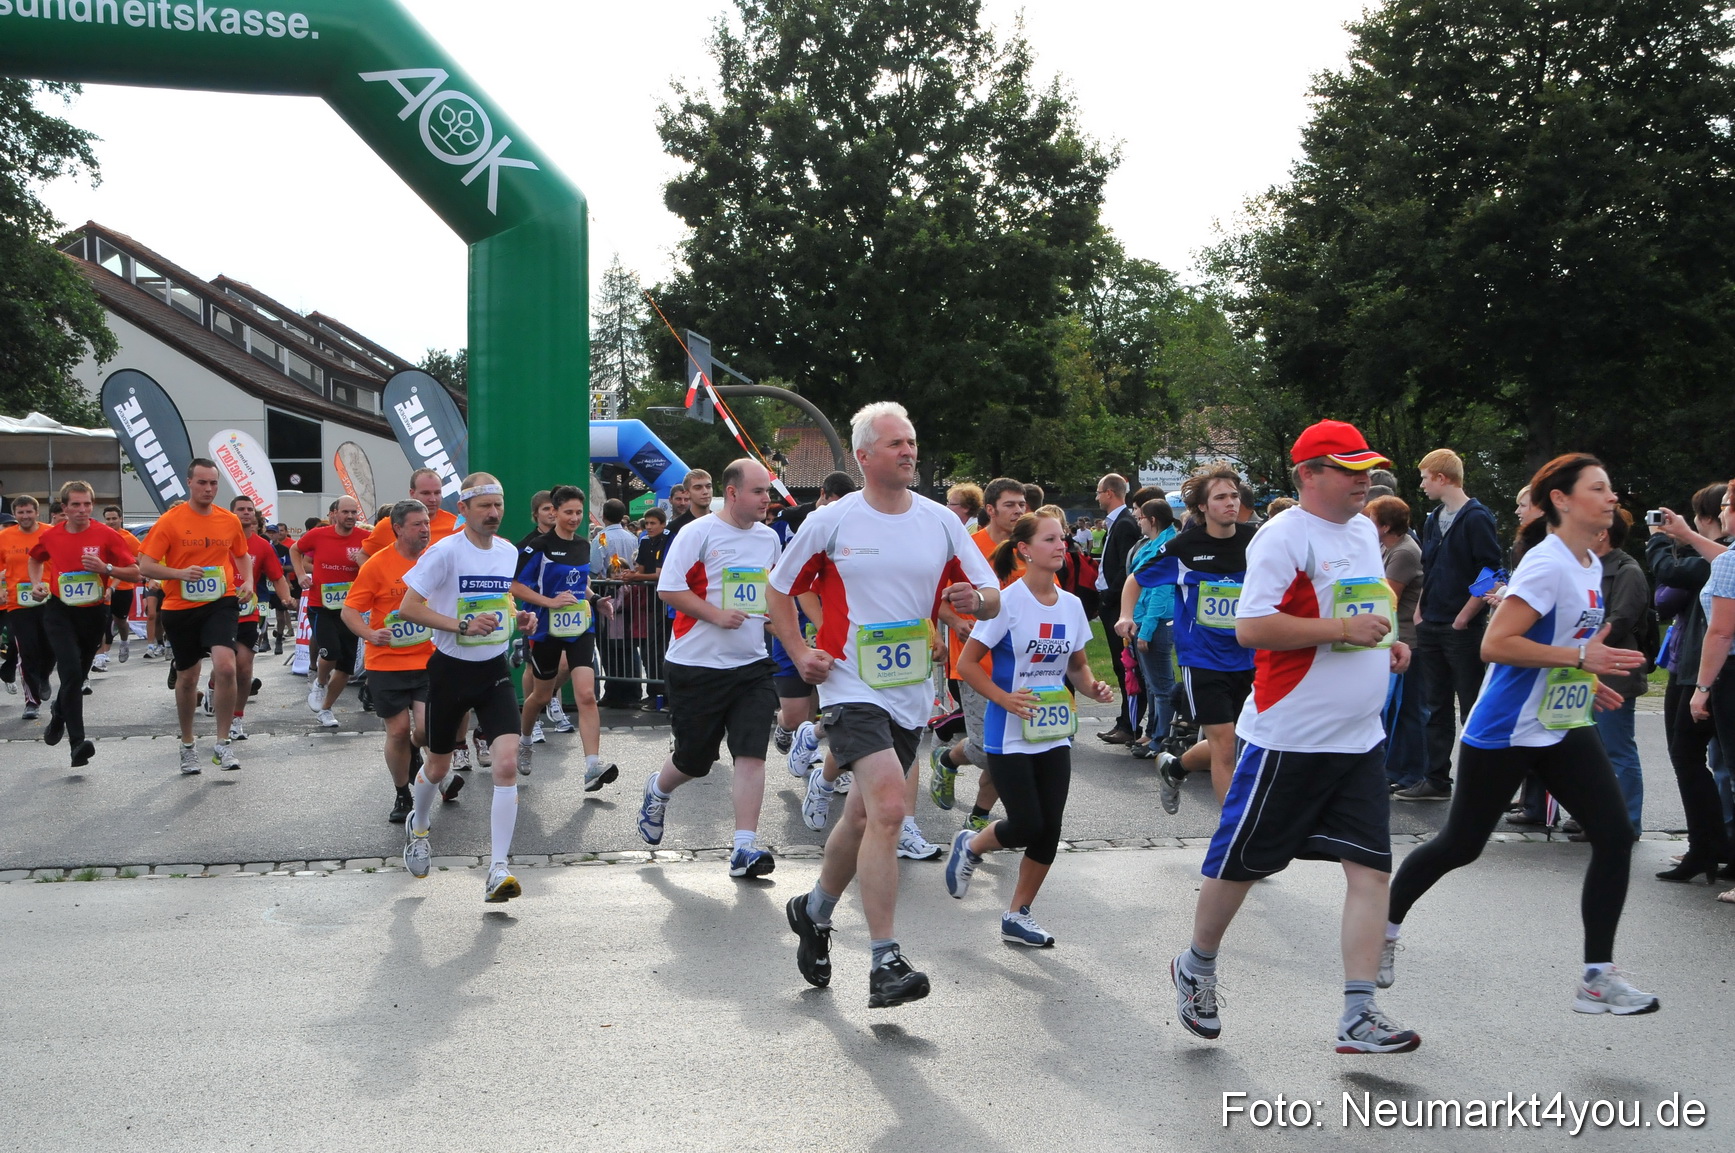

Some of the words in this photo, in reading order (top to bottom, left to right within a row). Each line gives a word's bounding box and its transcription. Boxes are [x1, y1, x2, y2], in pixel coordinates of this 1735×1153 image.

[358, 68, 540, 216] AOK
[63, 582, 94, 598] 947
[186, 578, 217, 594] 609
[391, 587, 407, 596] EUR
[734, 583, 757, 602] 40
[325, 591, 347, 604] 944
[553, 612, 582, 628] 304
[391, 621, 426, 639] 608
[1025, 640, 1070, 654] PERRAS
[876, 643, 912, 671] 36
[1546, 684, 1588, 710] 1260
[1029, 705, 1070, 727] 1259
